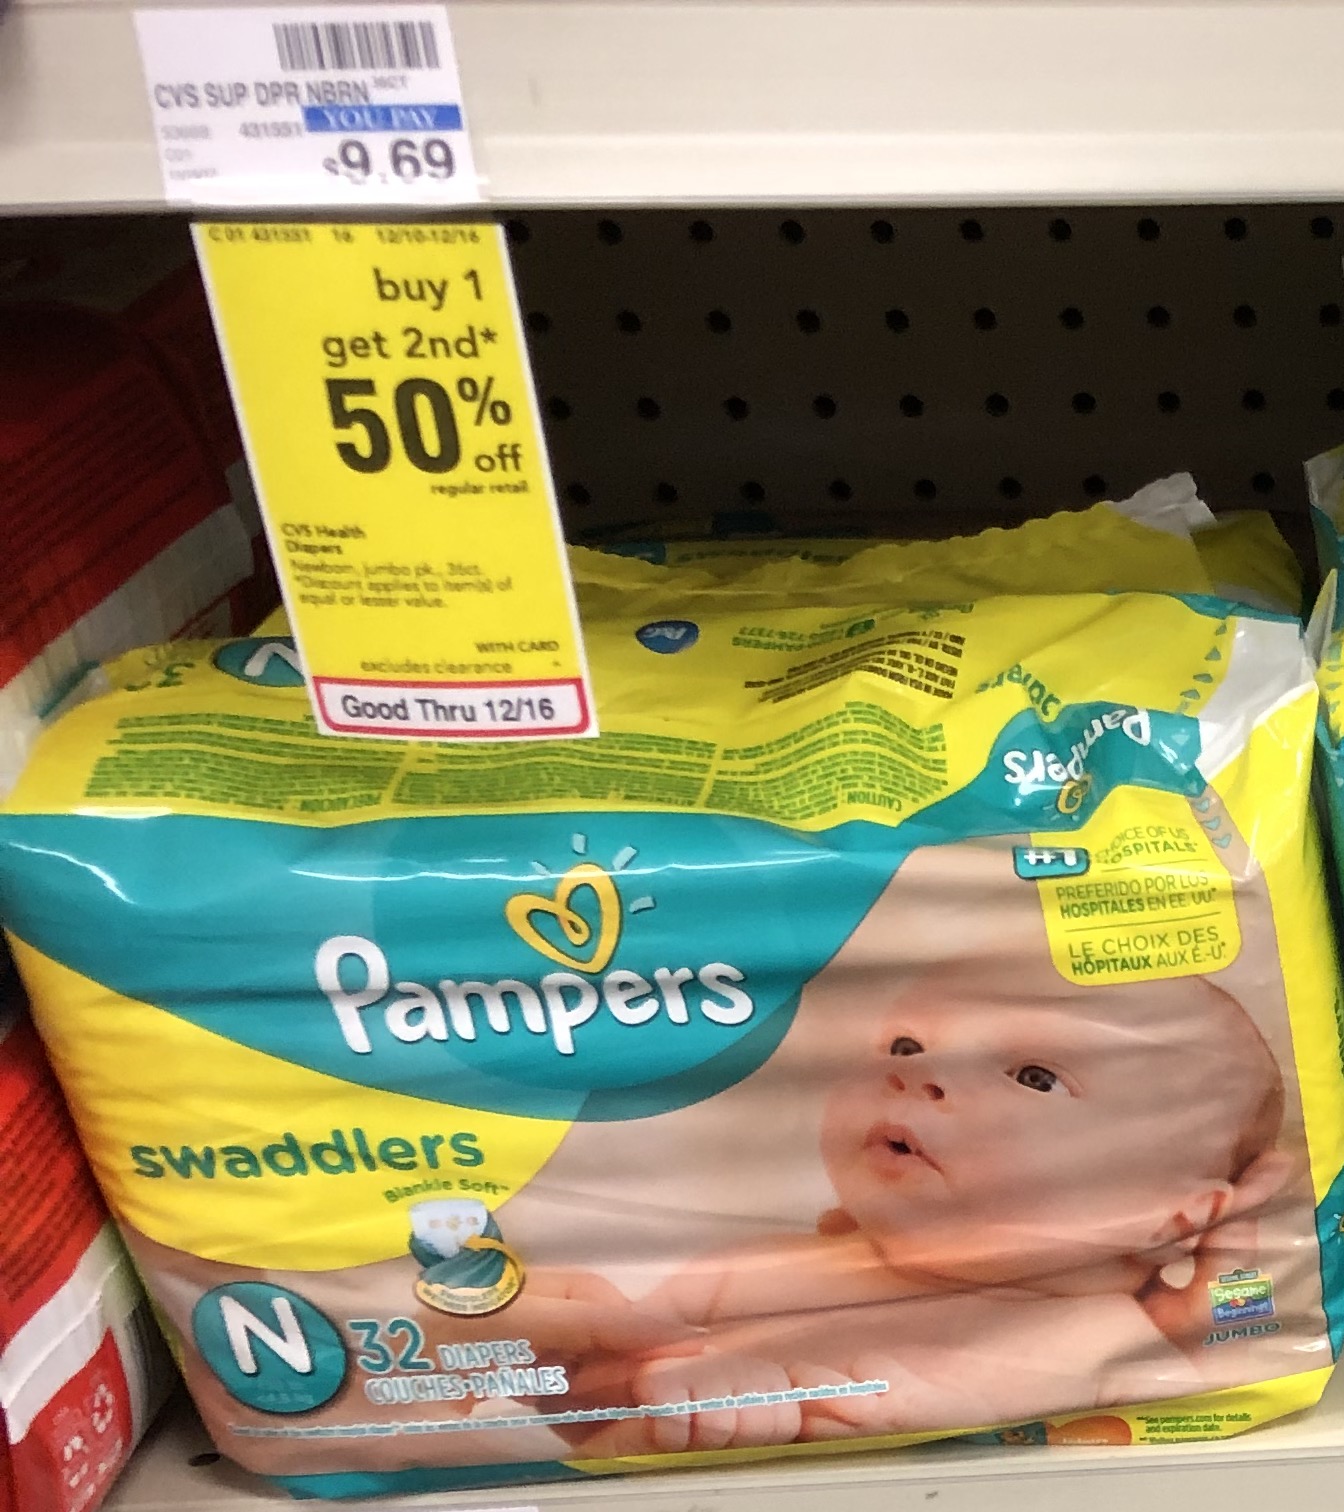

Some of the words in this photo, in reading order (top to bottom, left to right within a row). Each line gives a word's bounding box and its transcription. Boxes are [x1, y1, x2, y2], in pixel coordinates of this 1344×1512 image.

[155, 83, 199, 109] CVS
[206, 83, 247, 106] SUP
[255, 82, 299, 104] DPR
[307, 80, 370, 104] NBRN
[321, 108, 385, 129] YOU
[392, 107, 438, 128] PAY
[323, 139, 455, 186] $9.69
[374, 268, 448, 310] buy
[465, 269, 483, 301] 1
[323, 335, 387, 367] get
[475, 444, 523, 472] off
[342, 695, 409, 721] Good
[419, 697, 476, 722] Thru
[487, 699, 555, 722] 12/16
[313, 933, 754, 1055] Pampers
[132, 1127, 486, 1179] swaddlers
[218, 1295, 312, 1375] N
[347, 1318, 435, 1374] 32
[439, 1339, 535, 1369] DIAPERS
[1202, 1320, 1281, 1346] JUMBO
